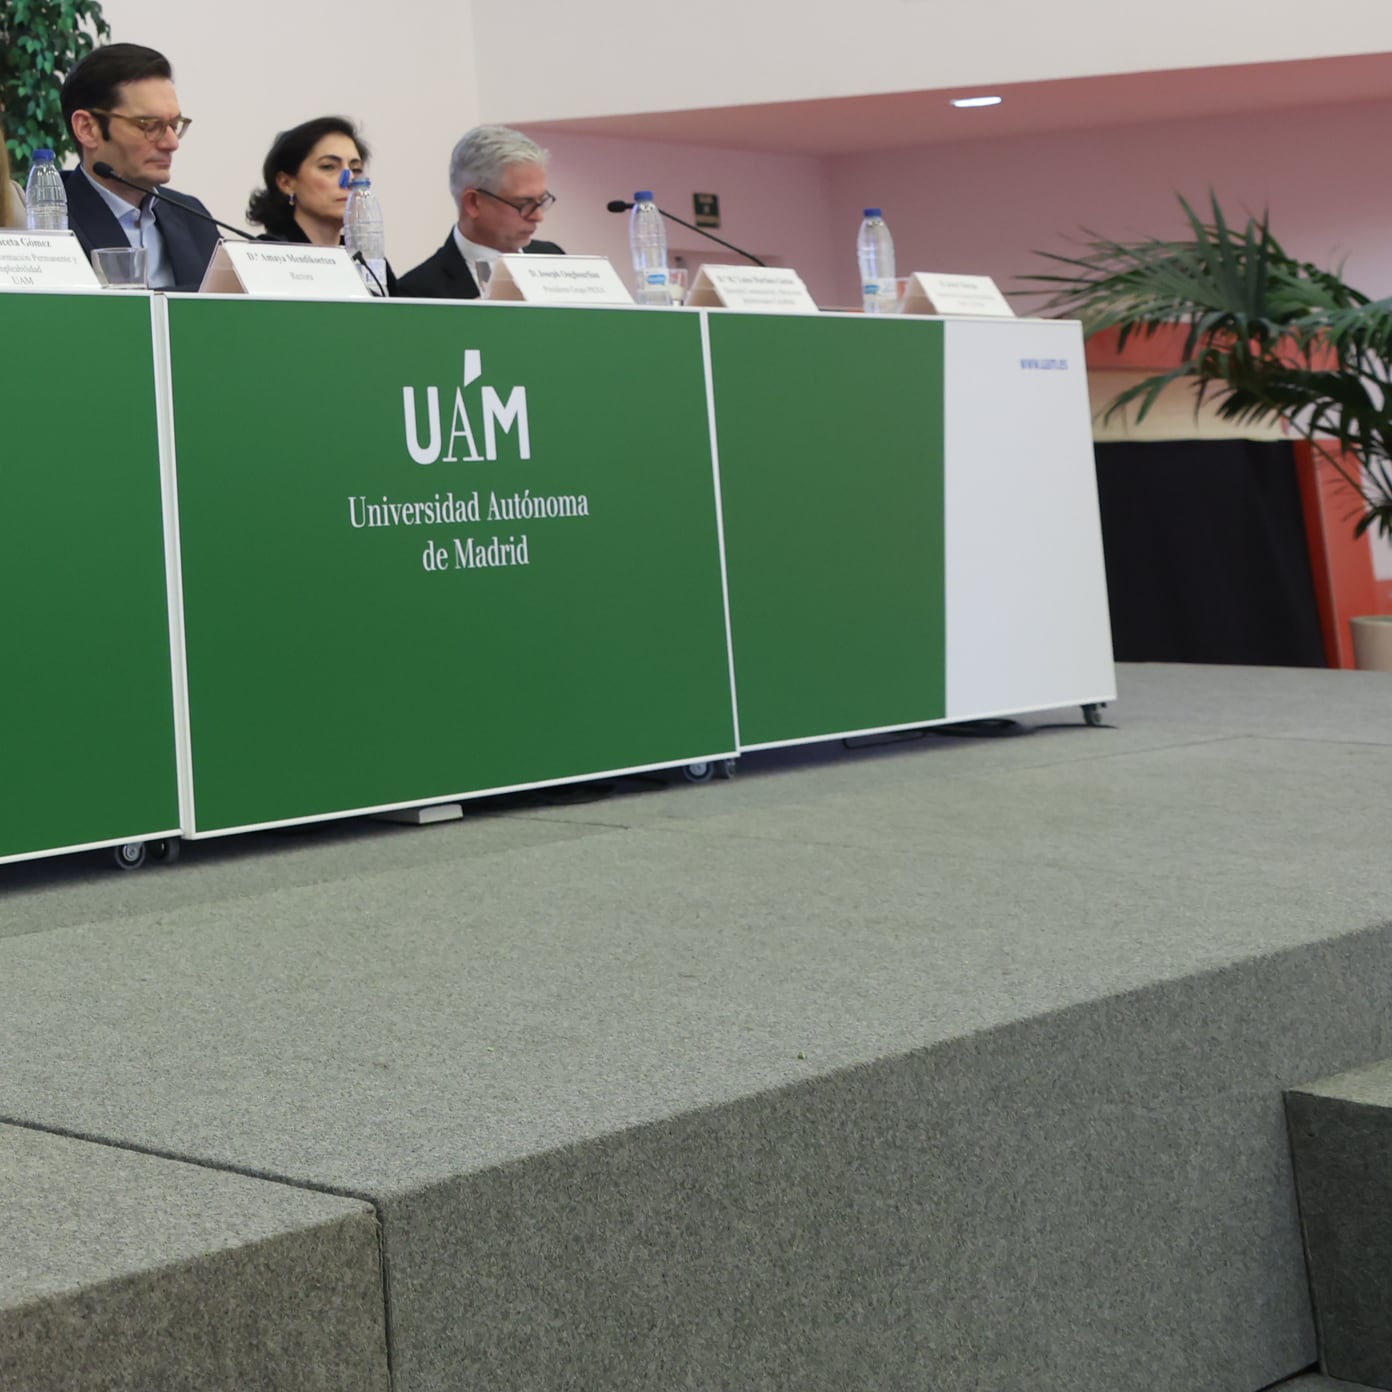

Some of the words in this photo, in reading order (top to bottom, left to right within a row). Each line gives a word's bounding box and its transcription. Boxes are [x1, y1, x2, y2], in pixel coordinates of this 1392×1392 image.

[11, 275, 34, 285] UAM
[348, 491, 481, 528] Universidad
[487, 488, 590, 522] Autónoma
[422, 540, 449, 572] de
[454, 535, 529, 570] Madrid
